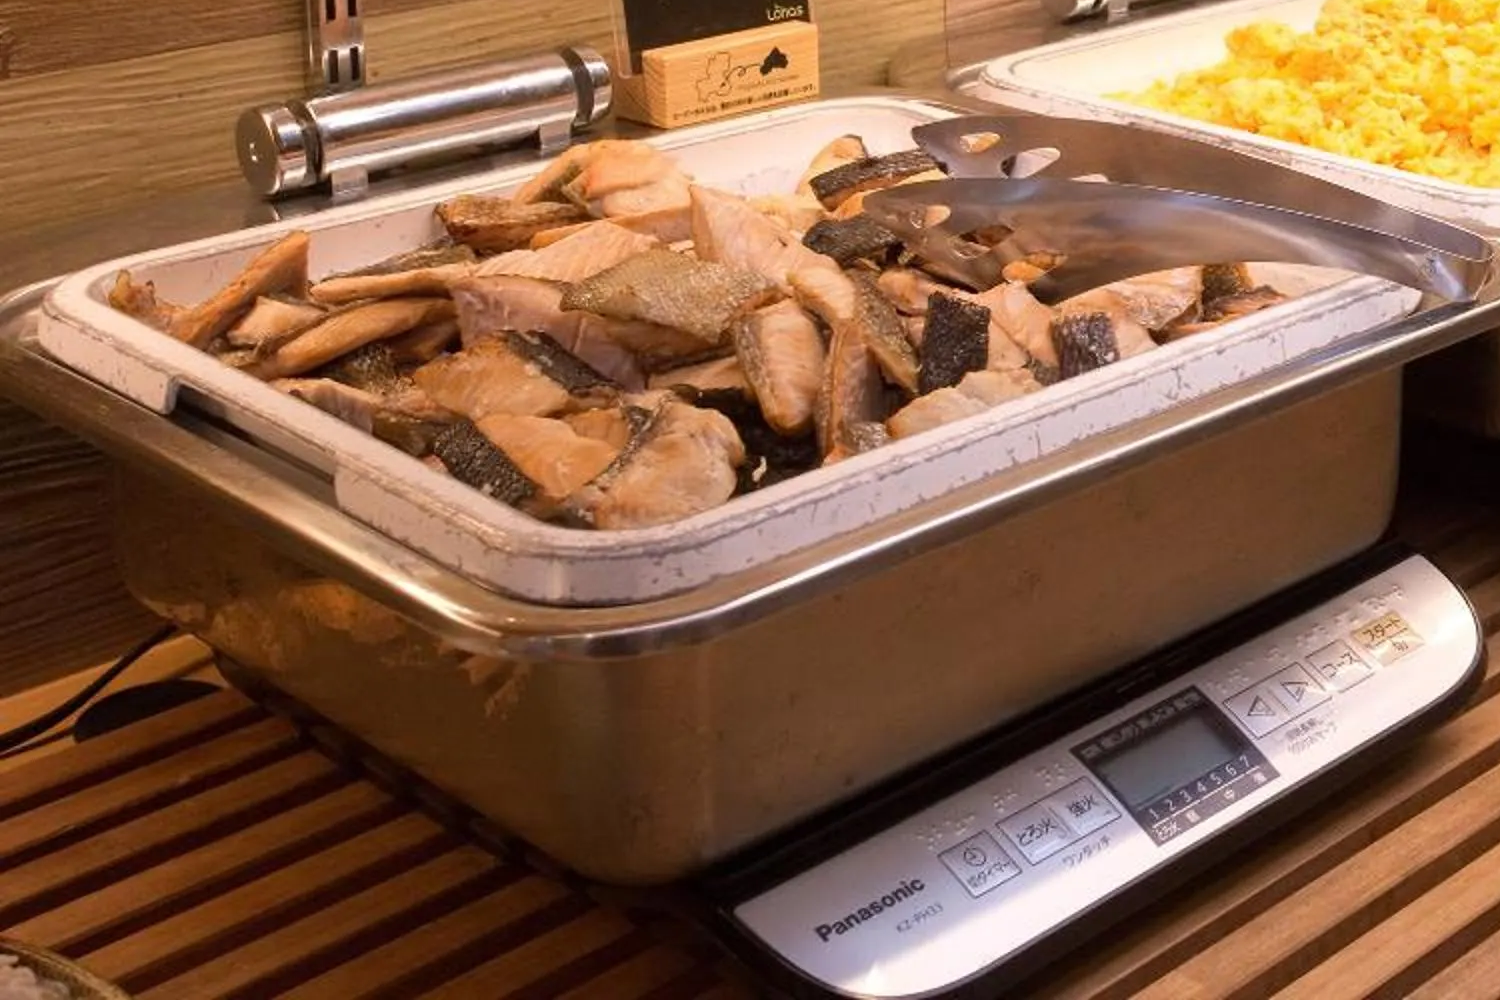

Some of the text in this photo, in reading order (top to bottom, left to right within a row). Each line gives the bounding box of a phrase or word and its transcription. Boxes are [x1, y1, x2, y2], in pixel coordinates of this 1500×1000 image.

[1225, 763, 1237, 777] 6
[1016, 818, 1058, 847] とろ火
[814, 878, 926, 942] Panasonic
